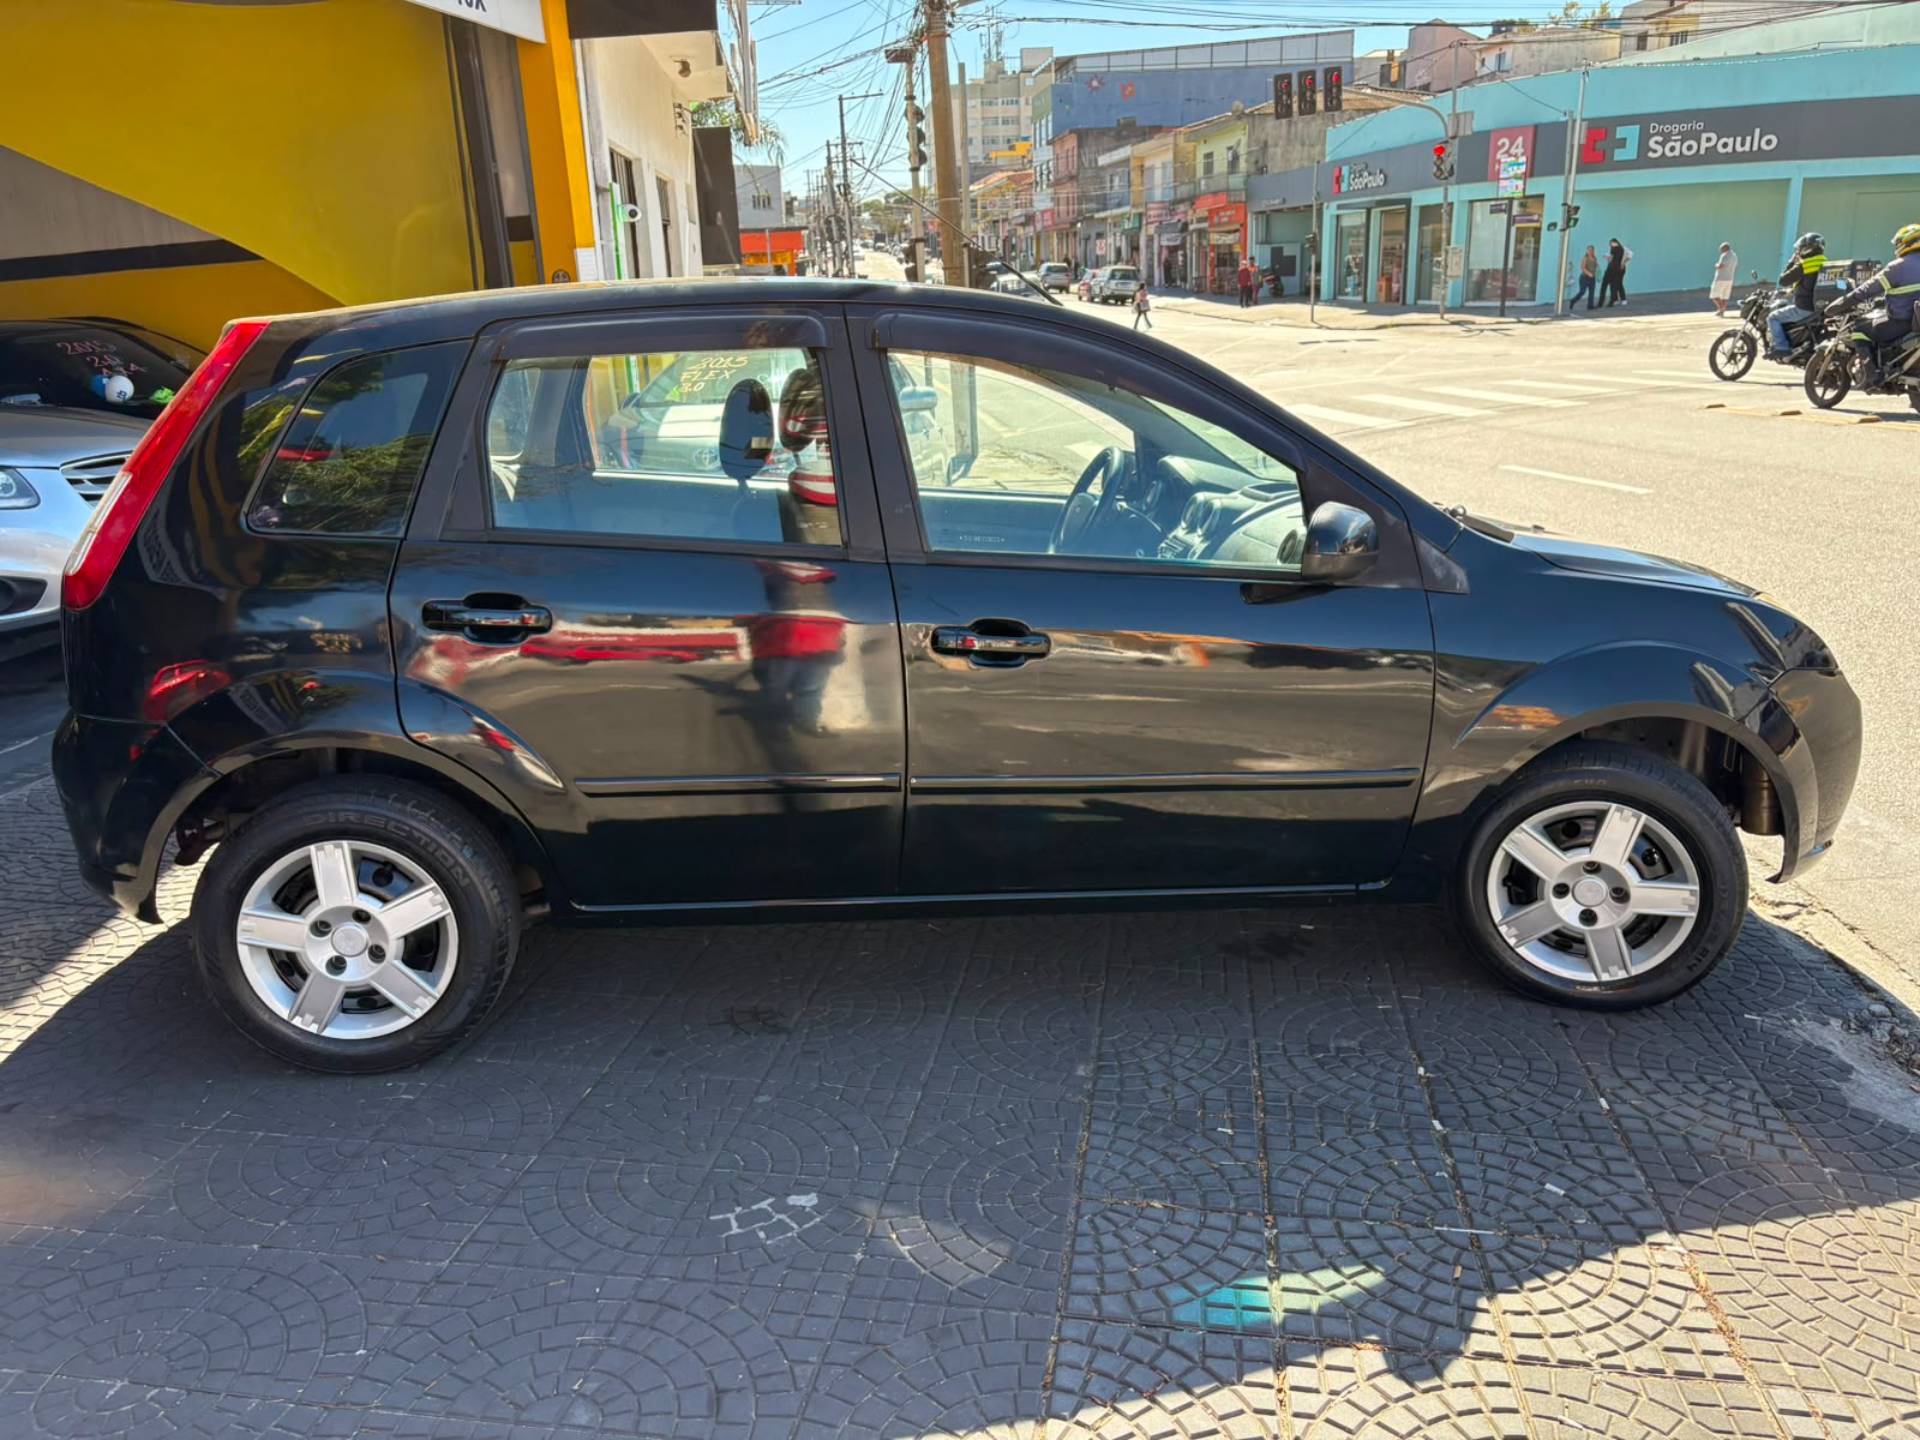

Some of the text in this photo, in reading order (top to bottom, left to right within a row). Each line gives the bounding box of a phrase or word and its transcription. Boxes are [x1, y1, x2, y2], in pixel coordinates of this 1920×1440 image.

[1647, 128, 1778, 159] SãoPaulo
[1650, 121, 1704, 144] Drogaria
[1496, 136, 1525, 159] 24
[681, 369, 736, 382] FLEX
